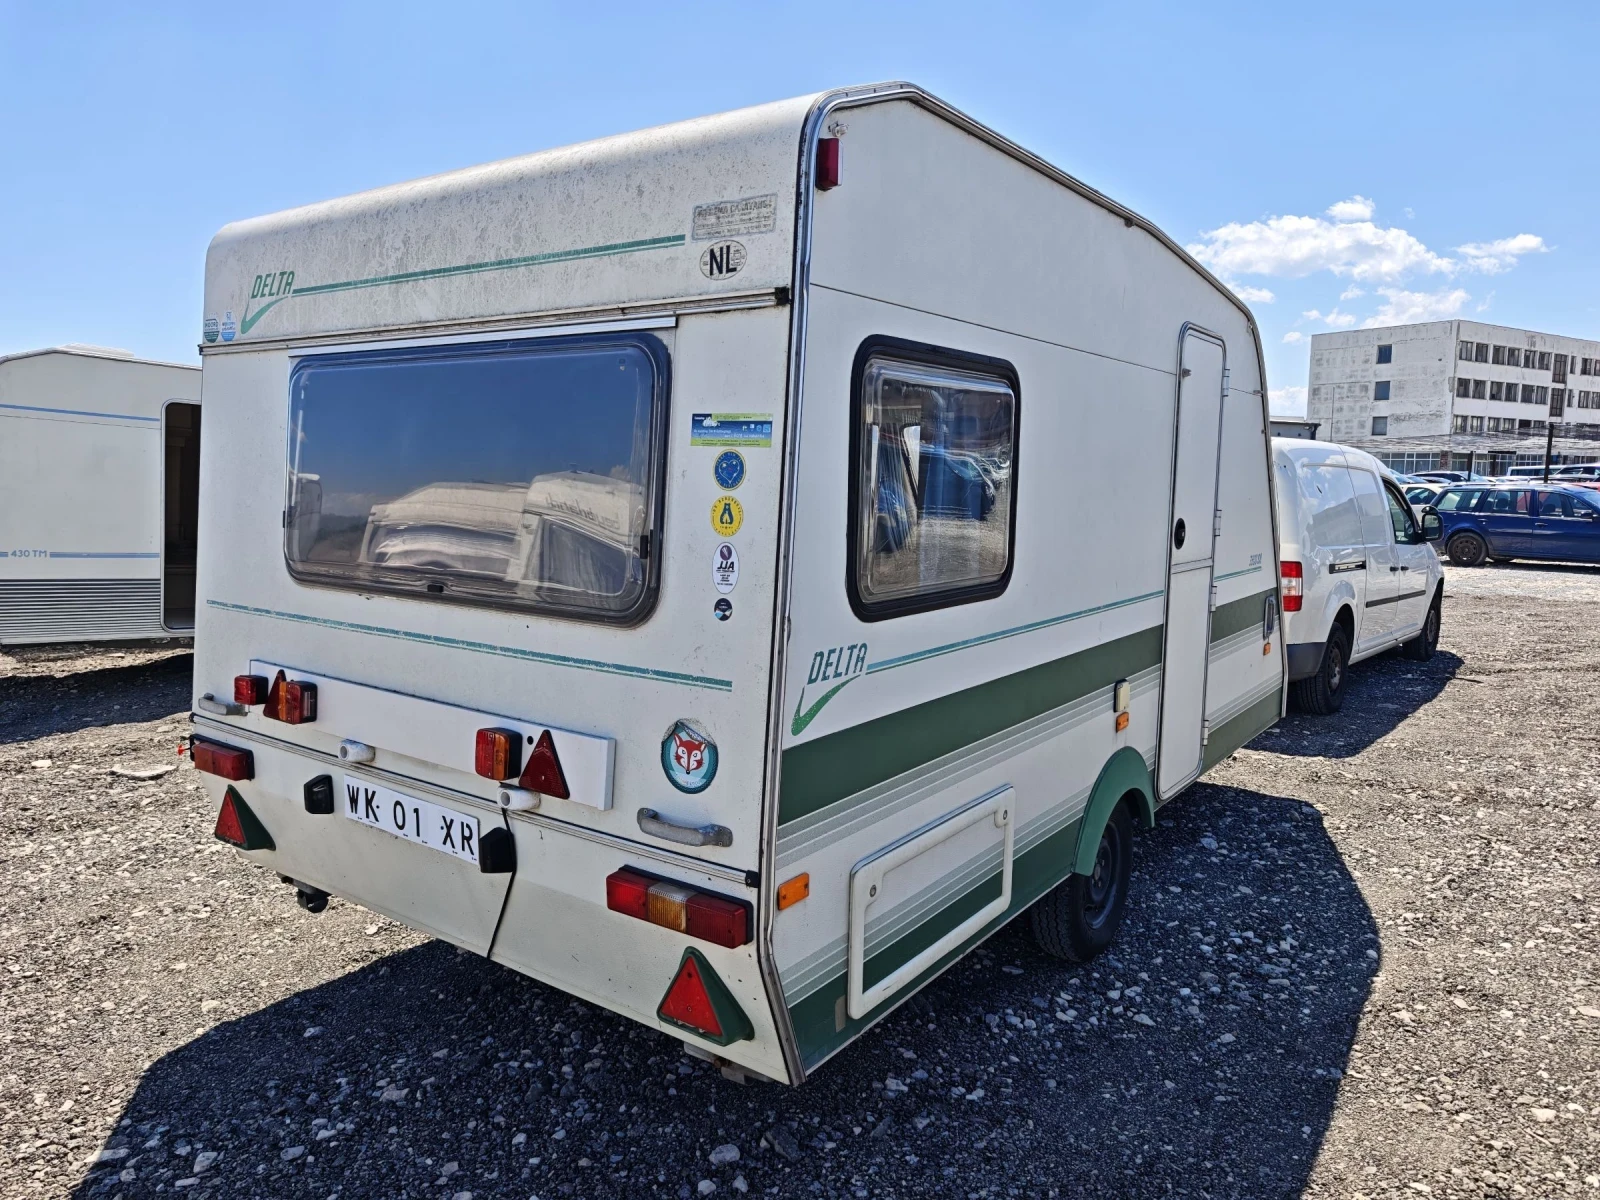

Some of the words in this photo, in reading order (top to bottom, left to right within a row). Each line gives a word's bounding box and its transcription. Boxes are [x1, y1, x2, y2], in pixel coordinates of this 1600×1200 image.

[709, 245, 737, 276] NL
[250, 271, 295, 299] DELTA
[10, 549, 30, 558] 430
[32, 549, 47, 558] TM
[717, 560, 735, 570] JJA
[807, 642, 868, 685] DELTA
[347, 784, 379, 822] WK
[393, 800, 420, 837] 01
[442, 815, 474, 855] XR
